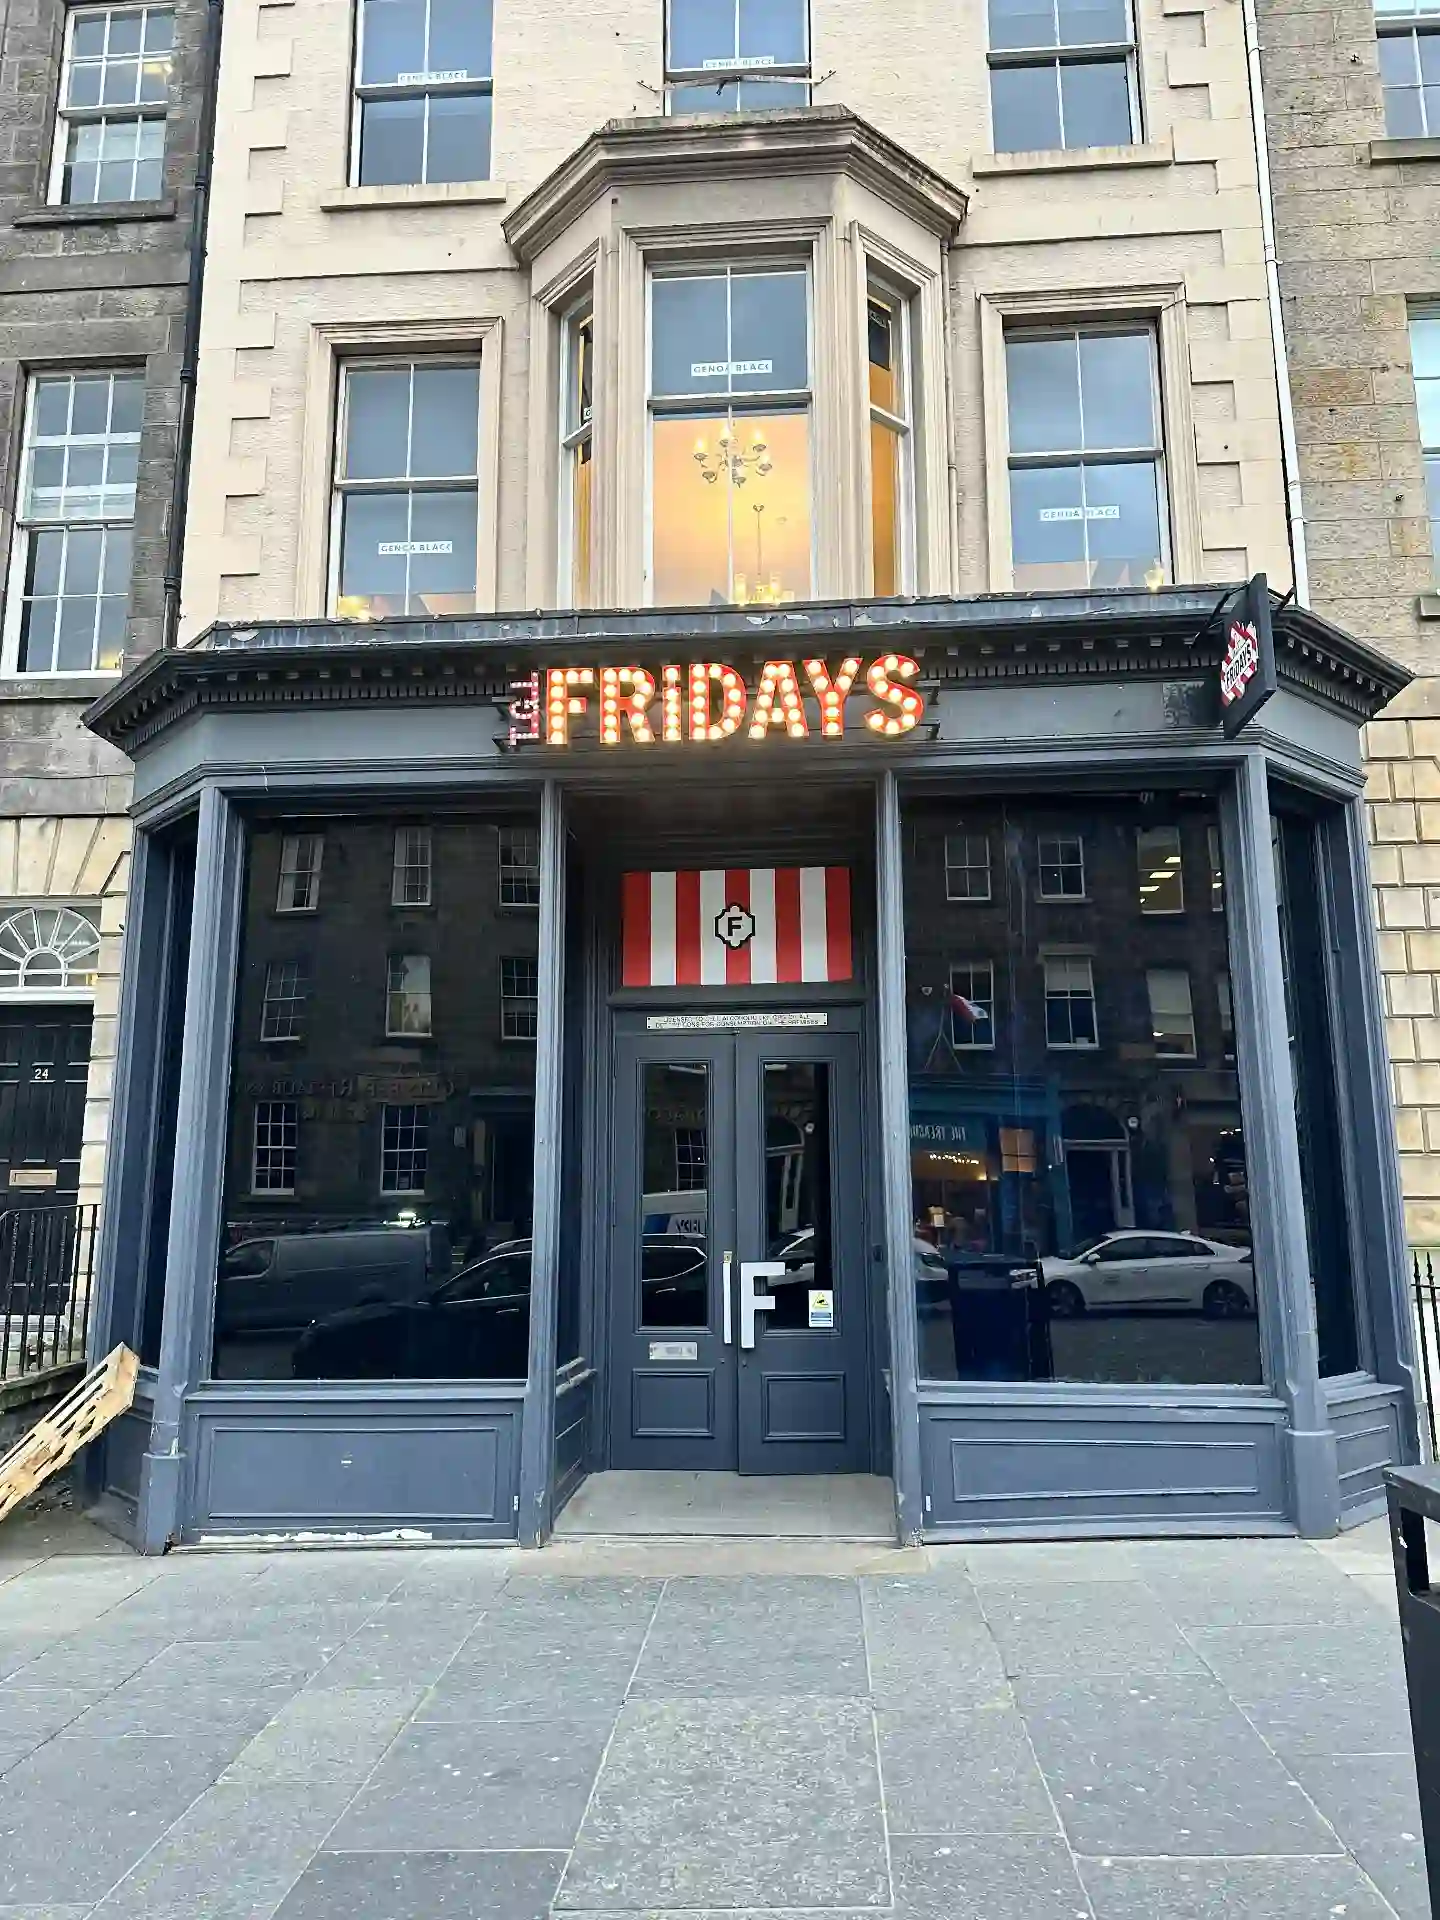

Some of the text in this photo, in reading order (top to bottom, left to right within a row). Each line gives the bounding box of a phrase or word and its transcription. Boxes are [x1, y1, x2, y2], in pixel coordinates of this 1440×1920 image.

[1083, 508, 1117, 517] LACK
[728, 916, 743, 937] F
[34, 1068, 49, 1080] 24
